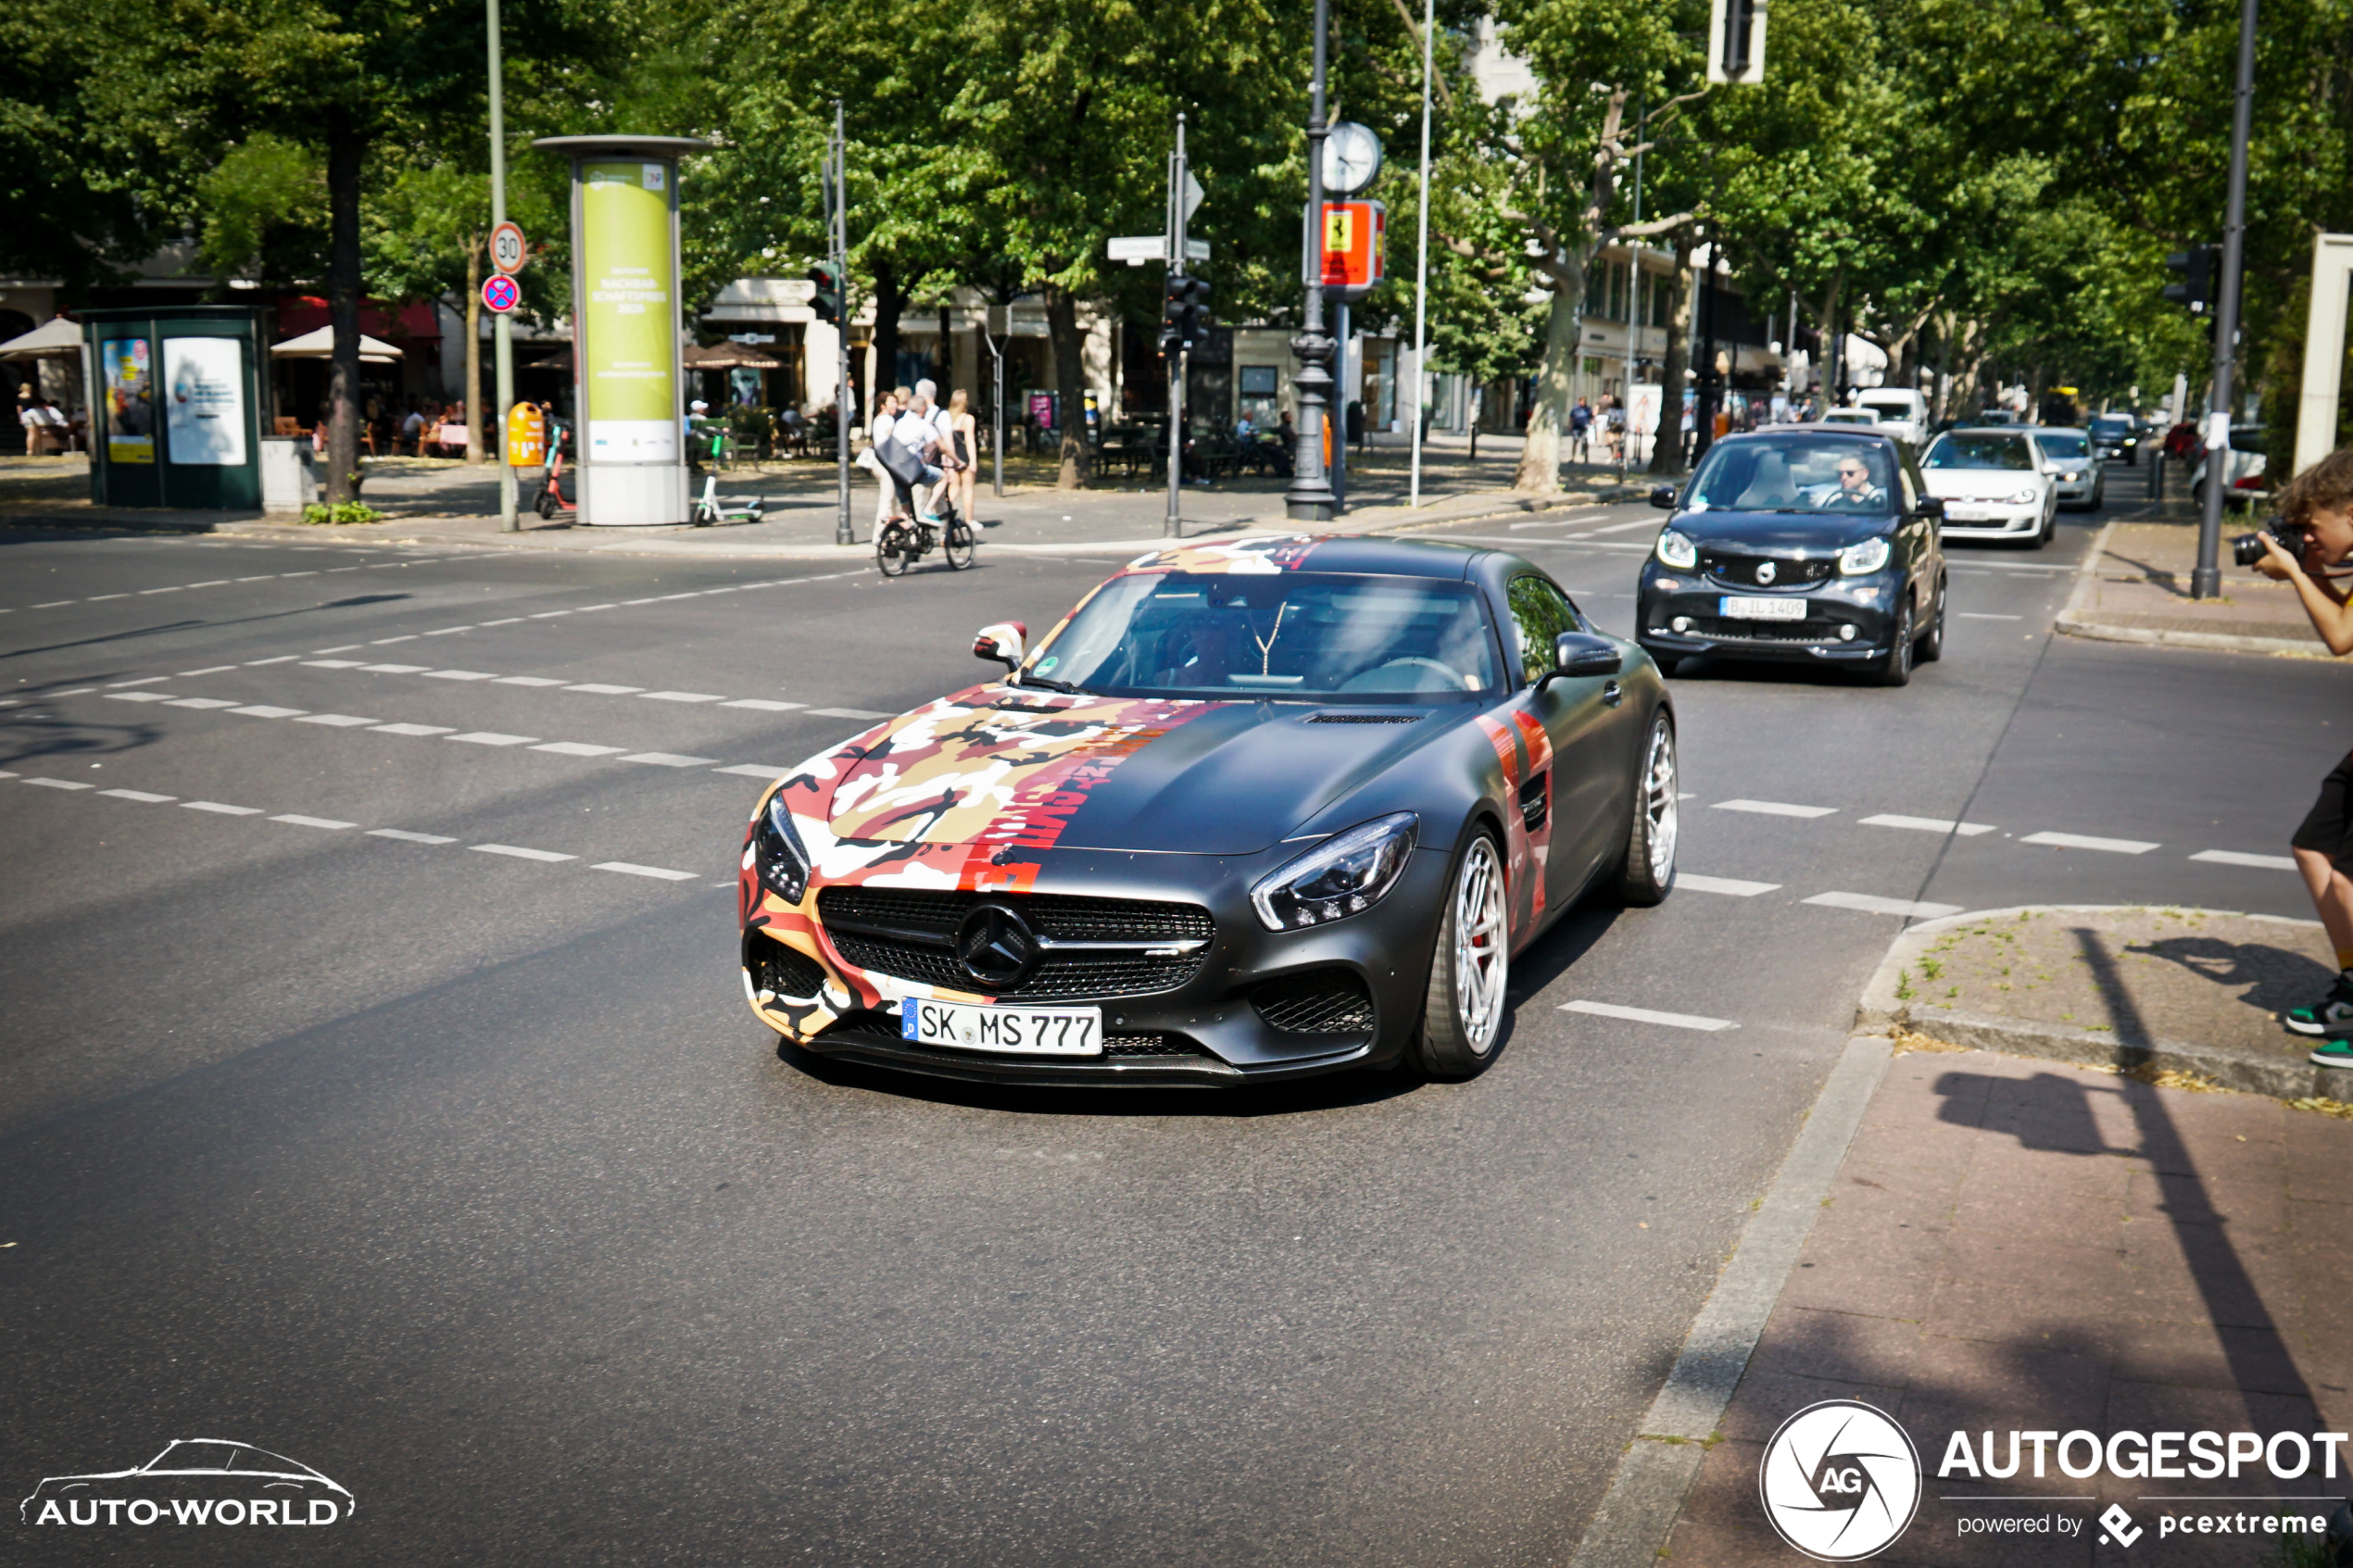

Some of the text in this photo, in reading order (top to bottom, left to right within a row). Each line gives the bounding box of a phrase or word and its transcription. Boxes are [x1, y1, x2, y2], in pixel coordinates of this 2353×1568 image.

[497, 236, 519, 259] 30
[1730, 599, 1804, 615] B IL 1409
[907, 1022, 915, 1034] D
[922, 1006, 1095, 1047] SK MS 777
